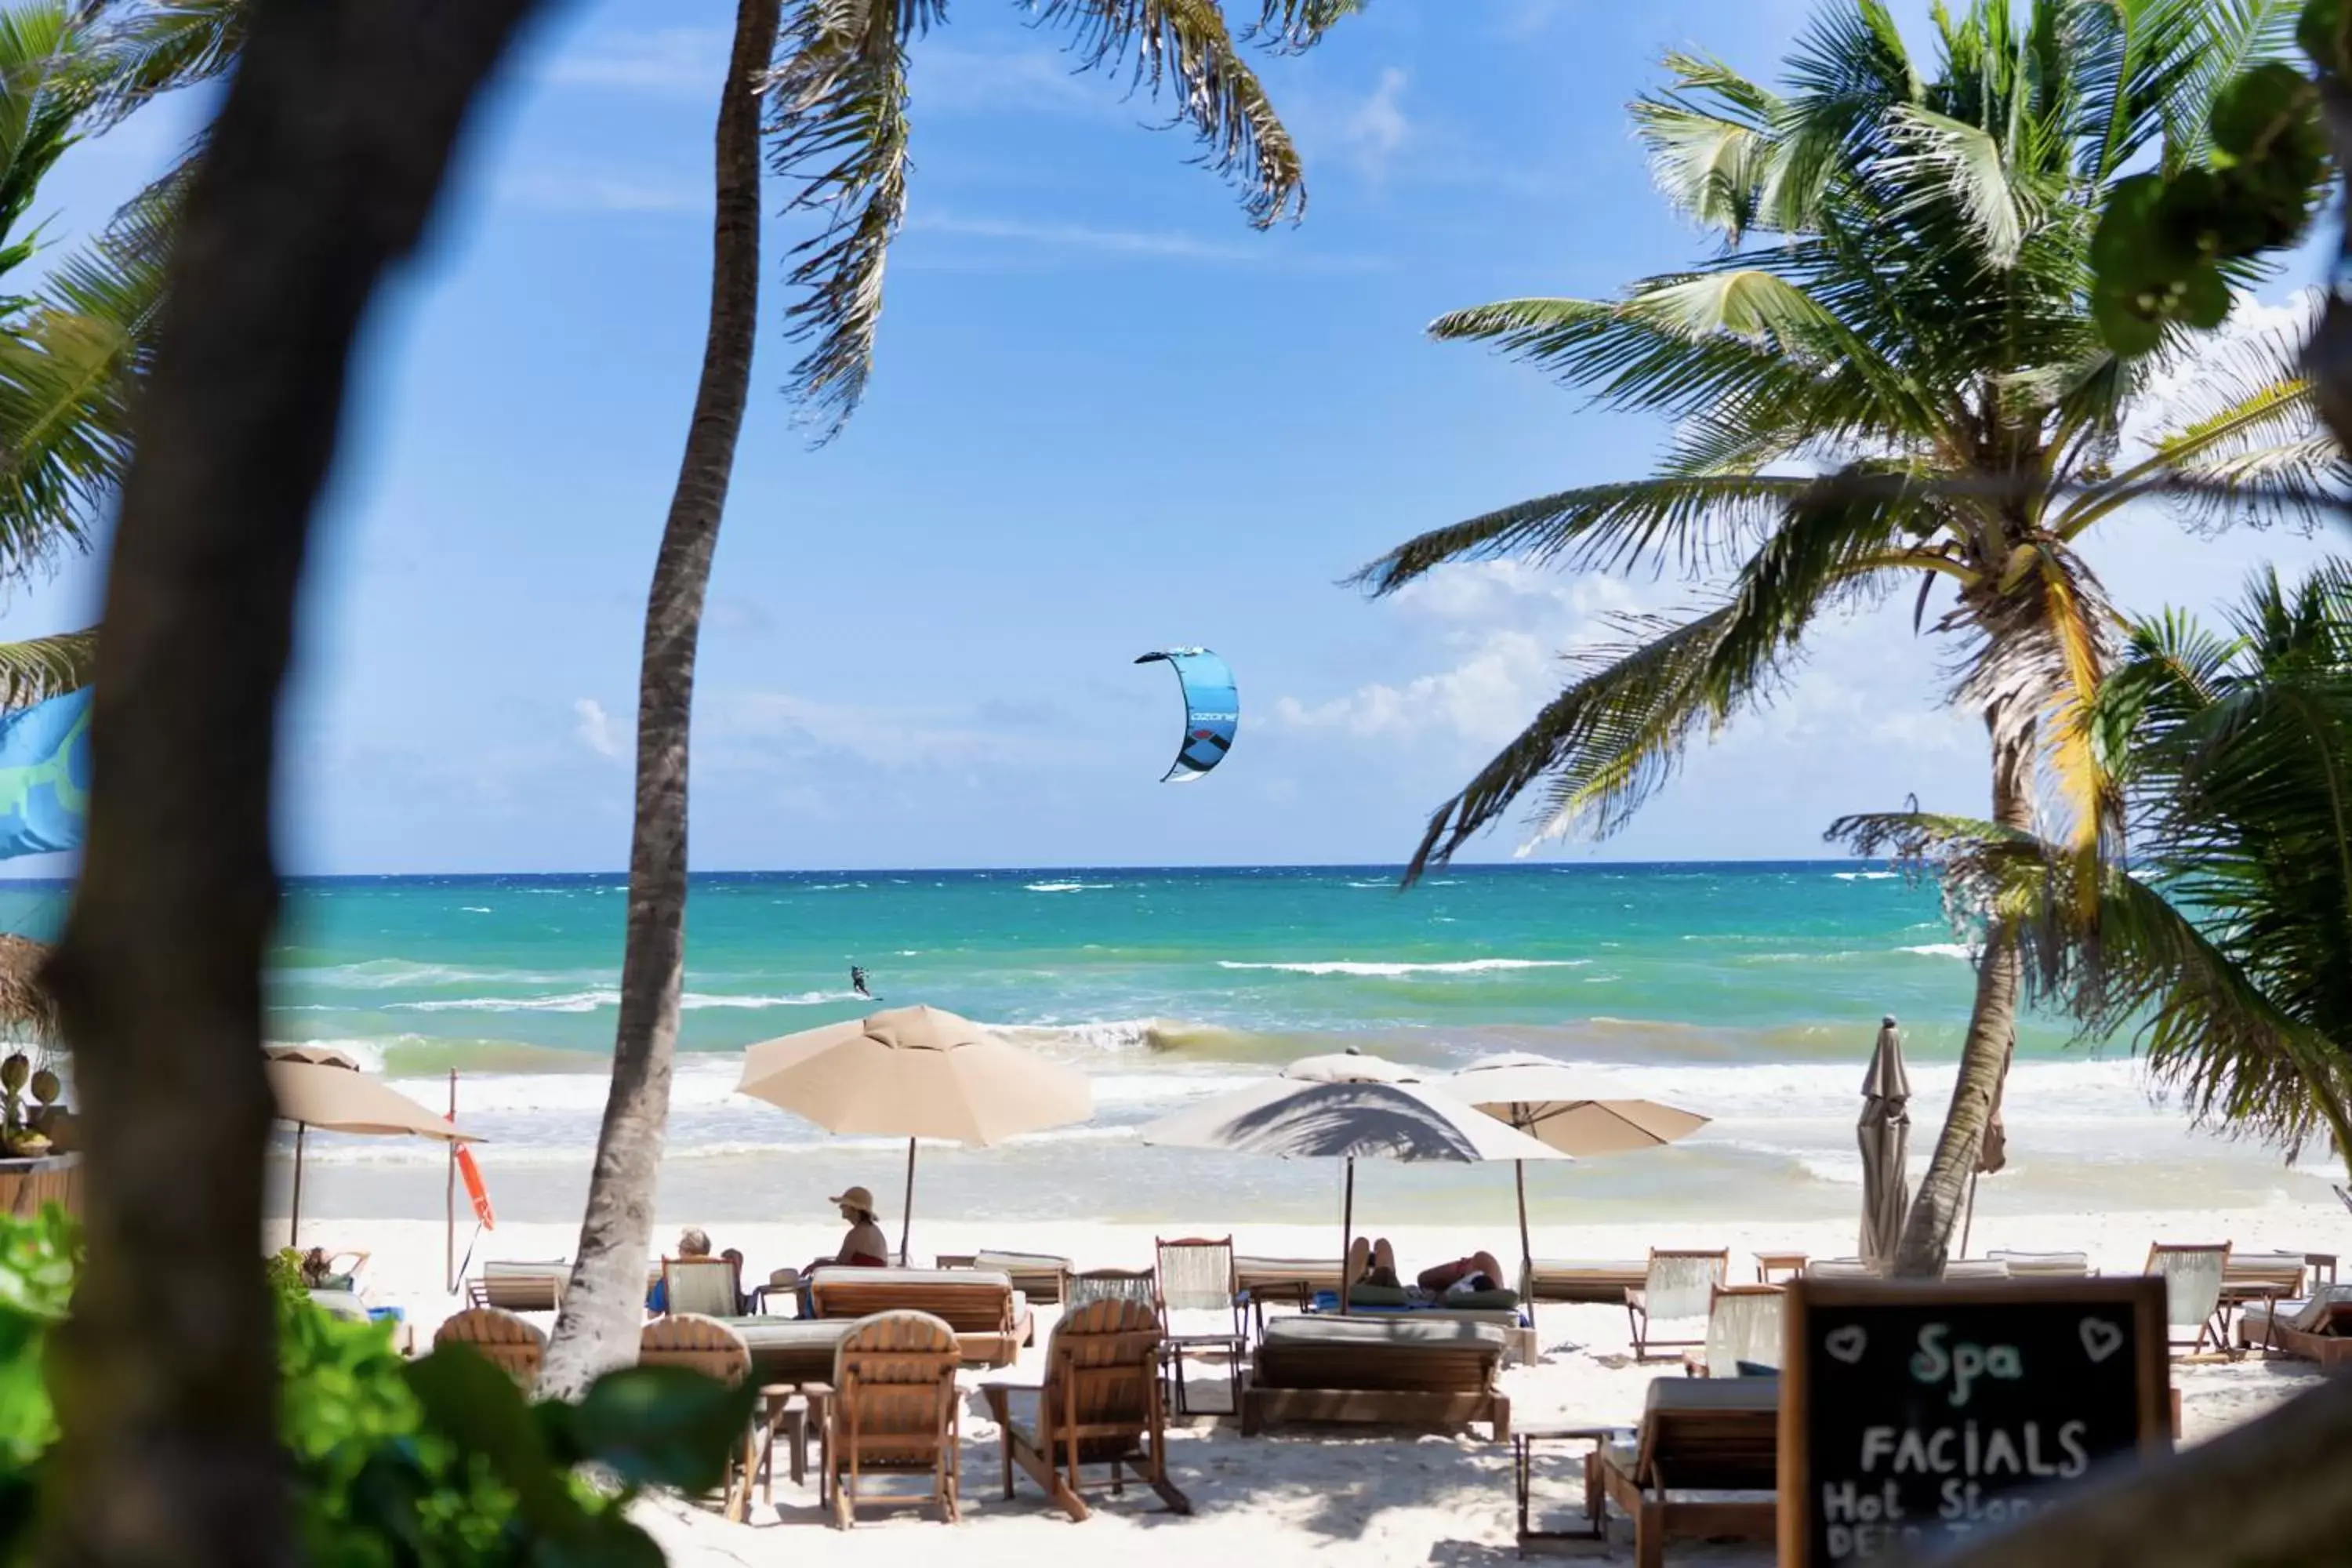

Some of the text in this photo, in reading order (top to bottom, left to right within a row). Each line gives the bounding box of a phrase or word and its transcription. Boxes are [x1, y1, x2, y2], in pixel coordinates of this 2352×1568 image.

[1910, 1323, 2023, 1406] Spa
[1860, 1420, 2089, 1479] FACIALS
[1822, 1479, 1904, 1522] Hot
